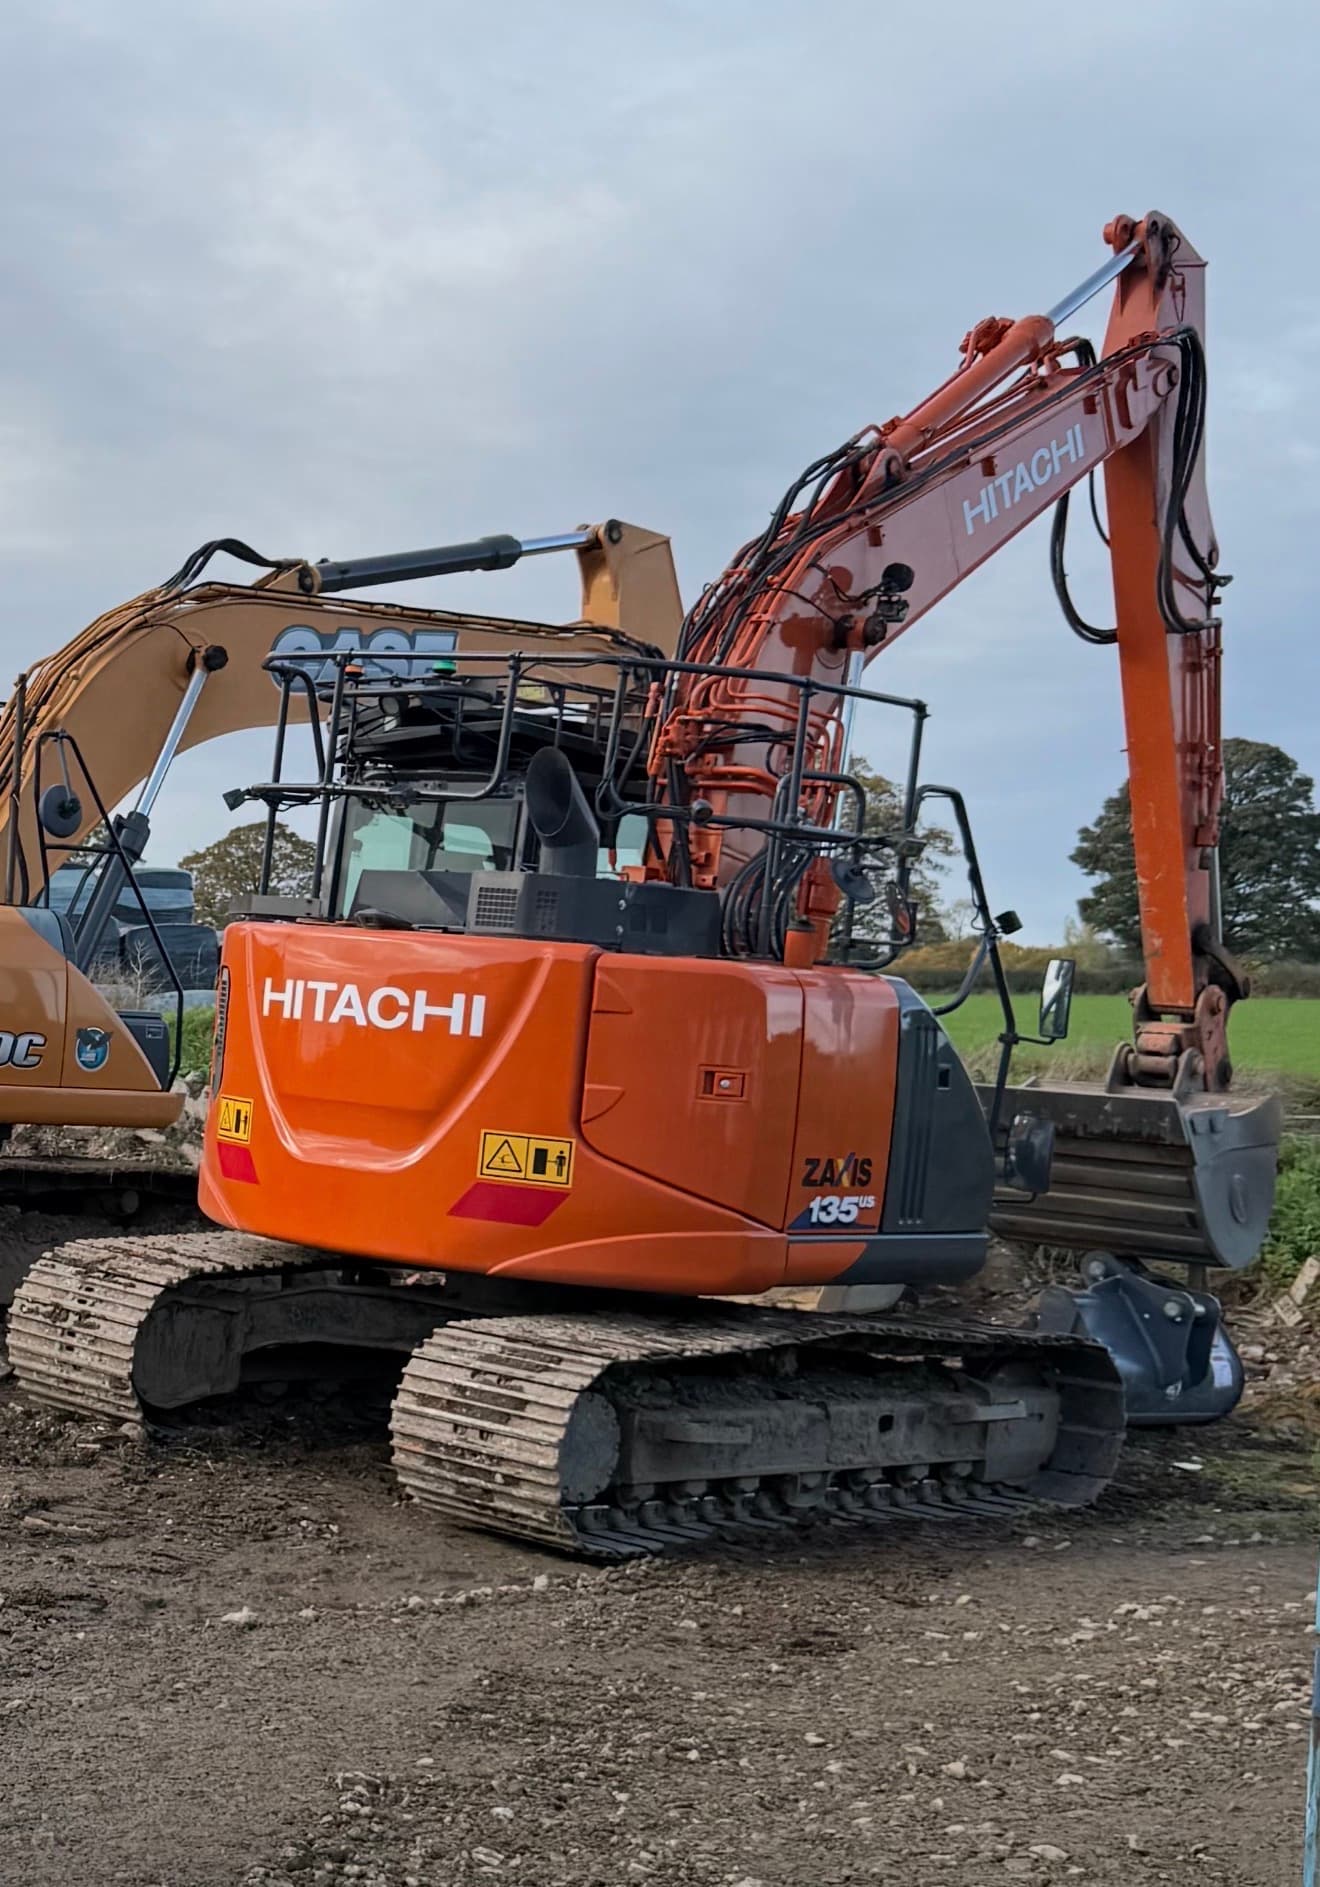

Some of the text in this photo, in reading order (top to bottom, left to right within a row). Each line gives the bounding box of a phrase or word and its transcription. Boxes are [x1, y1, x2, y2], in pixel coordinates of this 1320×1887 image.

[962, 423, 1085, 535] HITACHI
[262, 976, 487, 1037] HITACHI
[801, 1152, 873, 1187] ZAXIS
